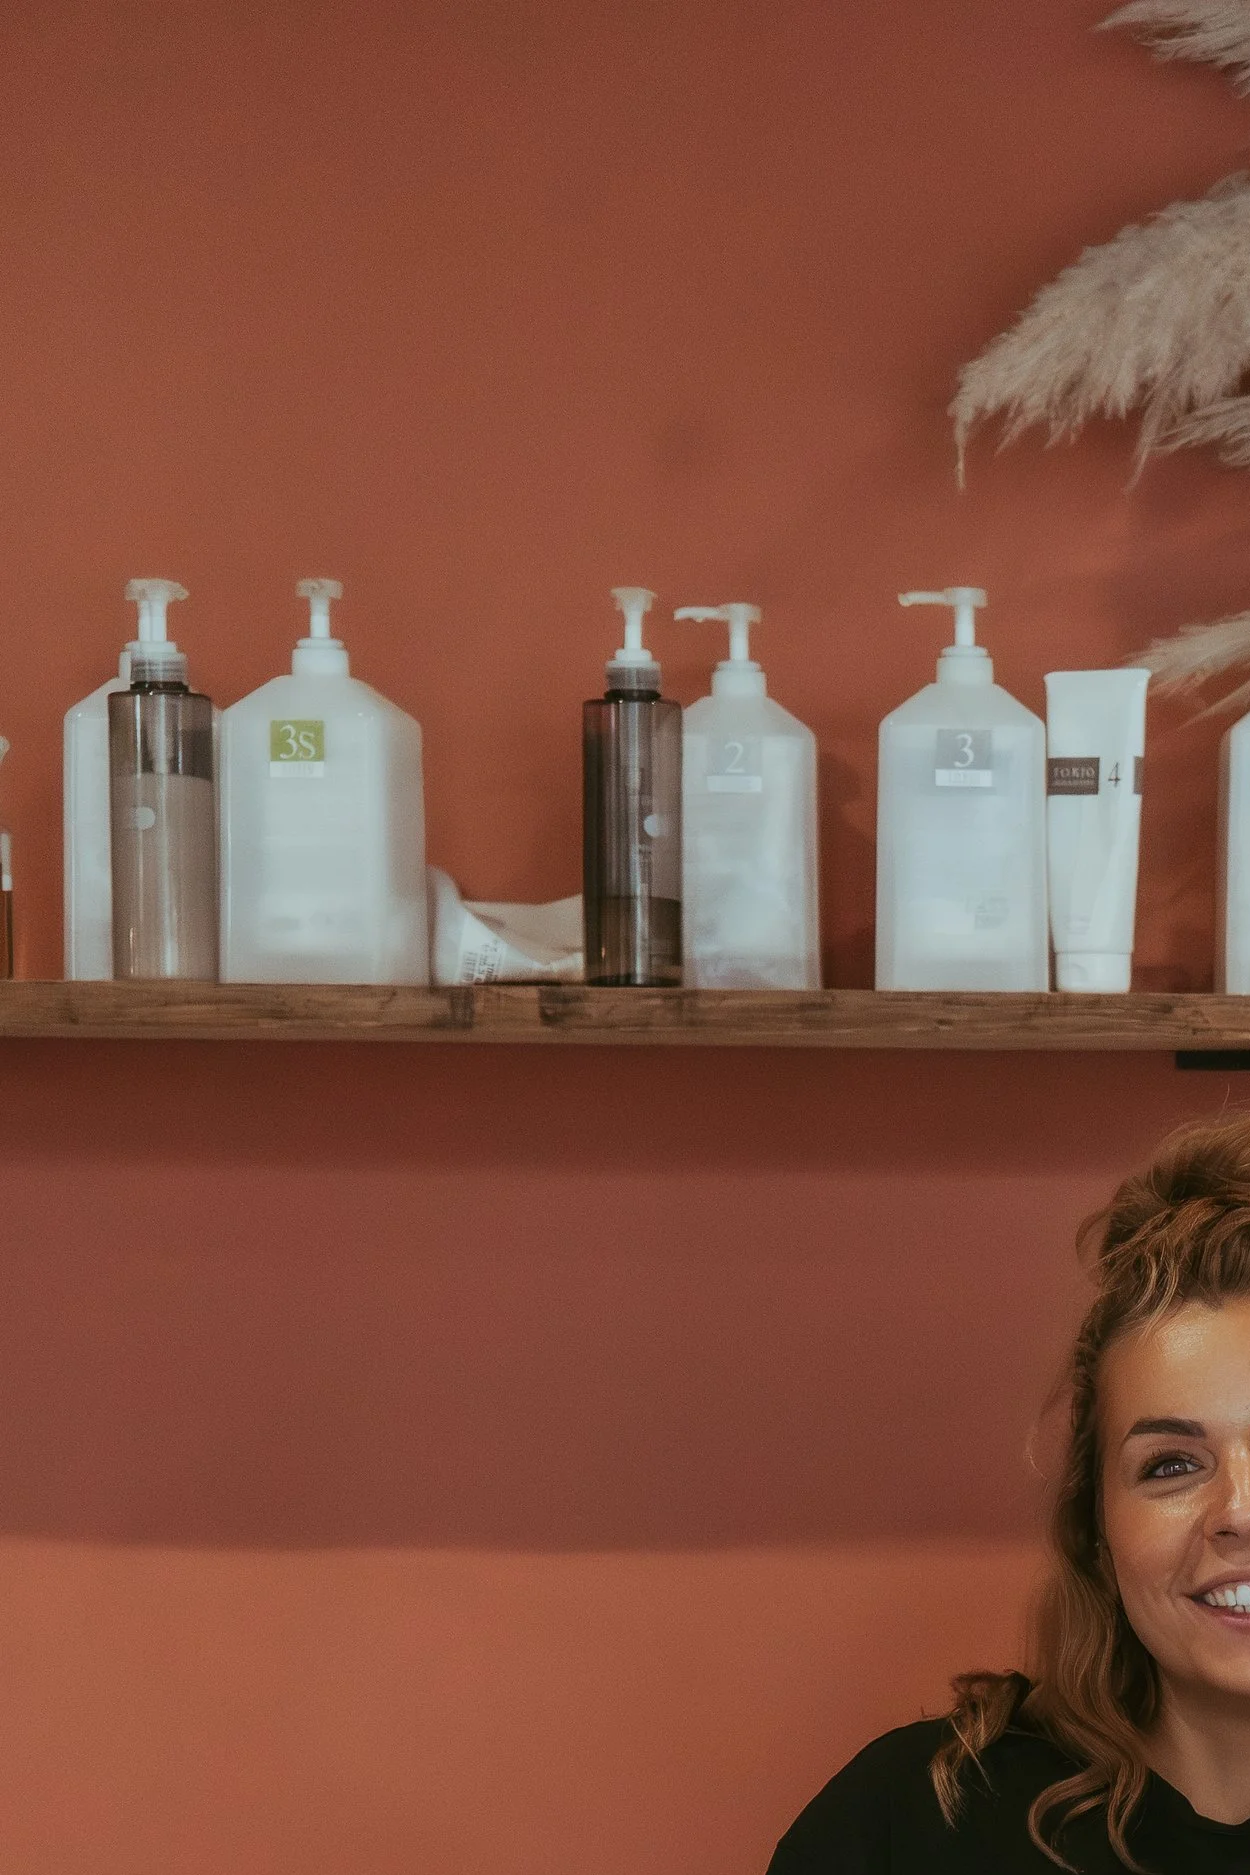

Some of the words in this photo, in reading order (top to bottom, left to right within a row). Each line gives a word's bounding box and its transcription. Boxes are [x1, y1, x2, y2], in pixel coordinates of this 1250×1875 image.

[723, 741, 746, 774] 2
[953, 733, 975, 768] 3
[1106, 761, 1122, 789] 4
